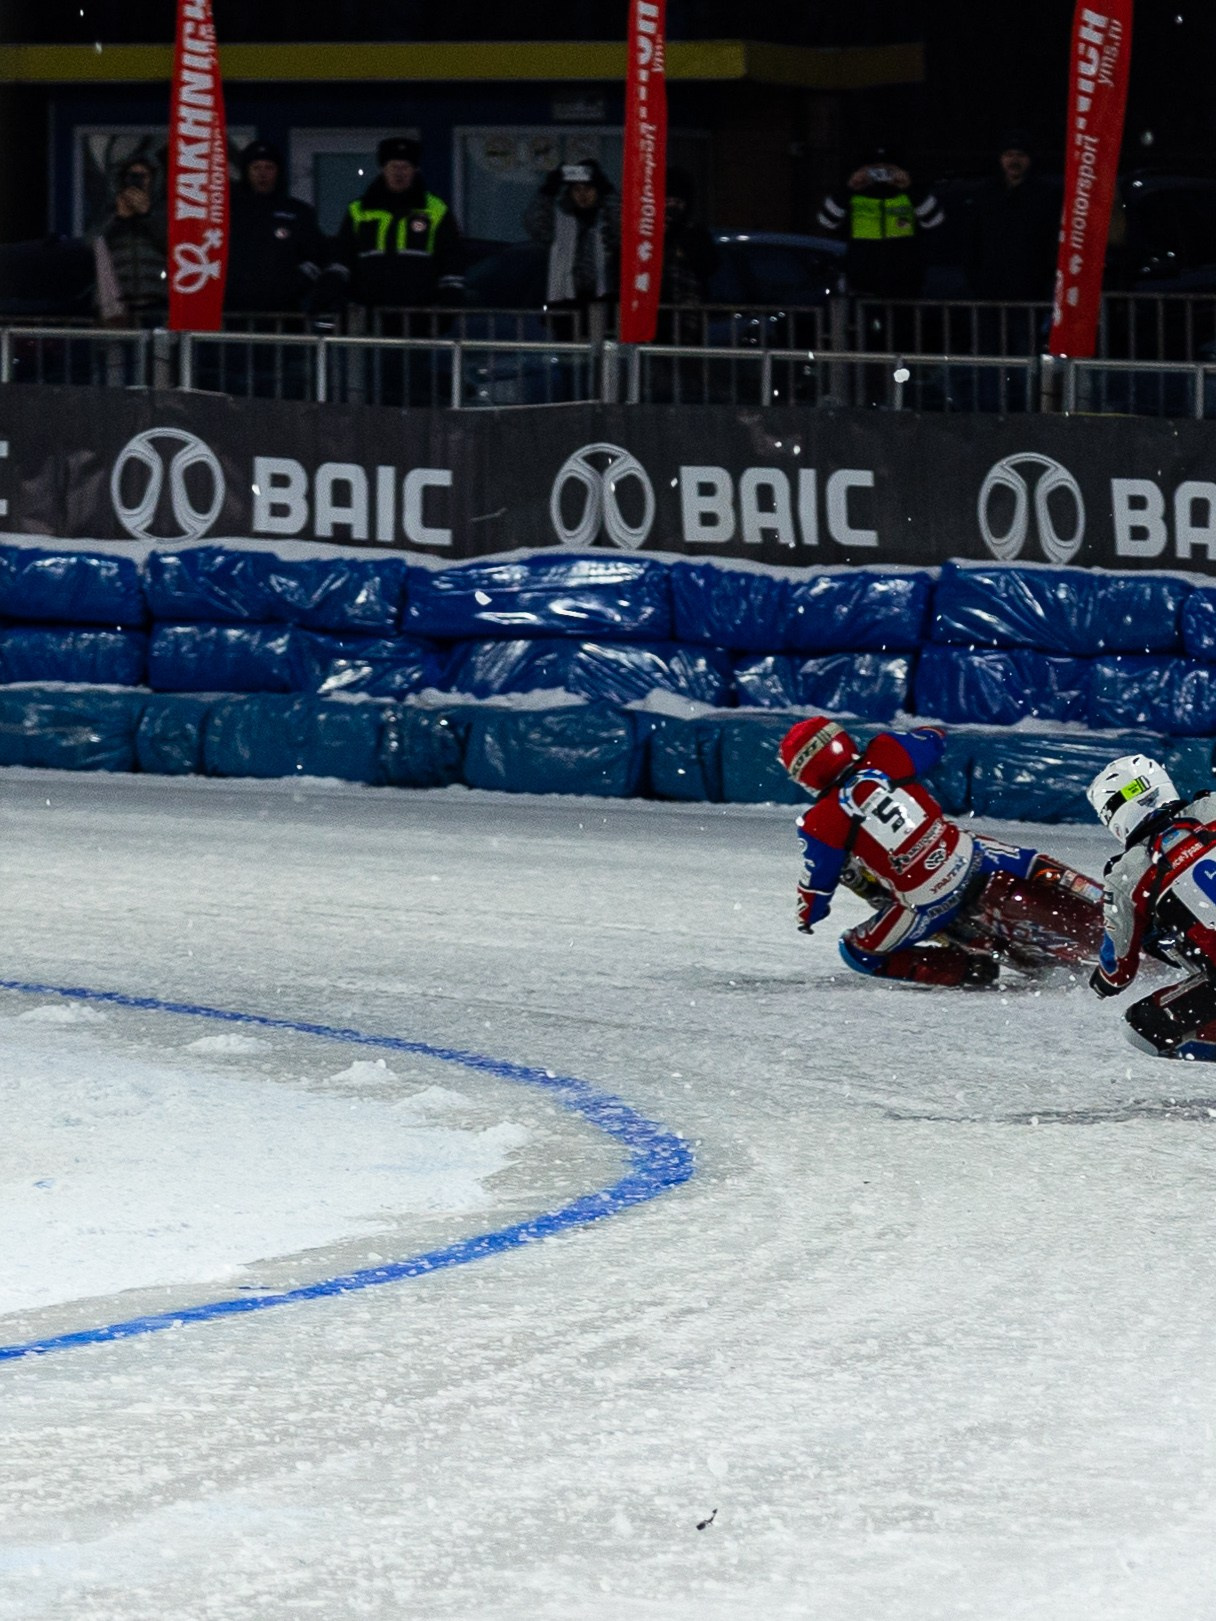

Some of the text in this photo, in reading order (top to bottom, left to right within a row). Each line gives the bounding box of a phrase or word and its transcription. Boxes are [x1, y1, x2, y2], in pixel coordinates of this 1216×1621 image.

[1098, 18, 1123, 88] yms.ru
[1070, 133, 1100, 250] motorsport
[252, 456, 453, 546] BAIC
[679, 466, 879, 546] BAIC
[872, 796, 905, 833] 5
